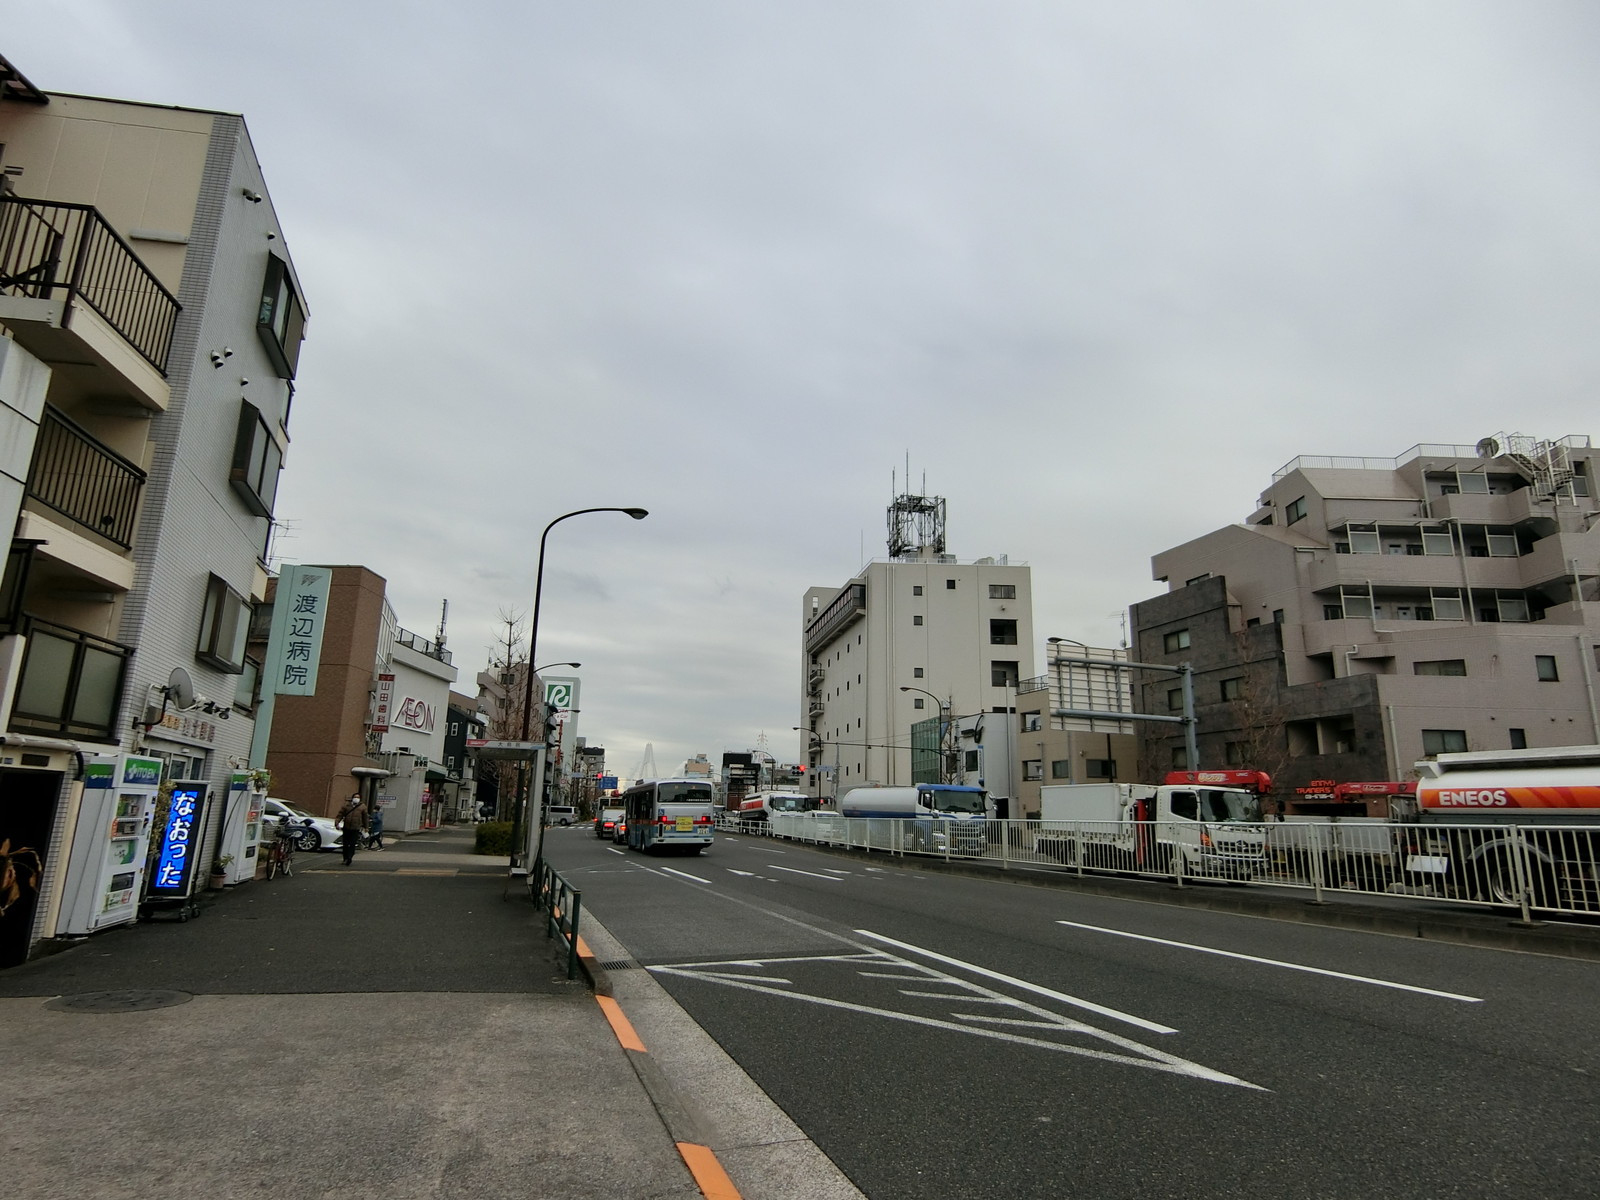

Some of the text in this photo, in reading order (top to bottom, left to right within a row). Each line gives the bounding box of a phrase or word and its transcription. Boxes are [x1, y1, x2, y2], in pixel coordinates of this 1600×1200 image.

[282, 593, 319, 686] 渡辺病院
[377, 681, 391, 724] 山田歯科
[1438, 790, 1507, 806] ENEOS
[161, 792, 195, 885] なおった
